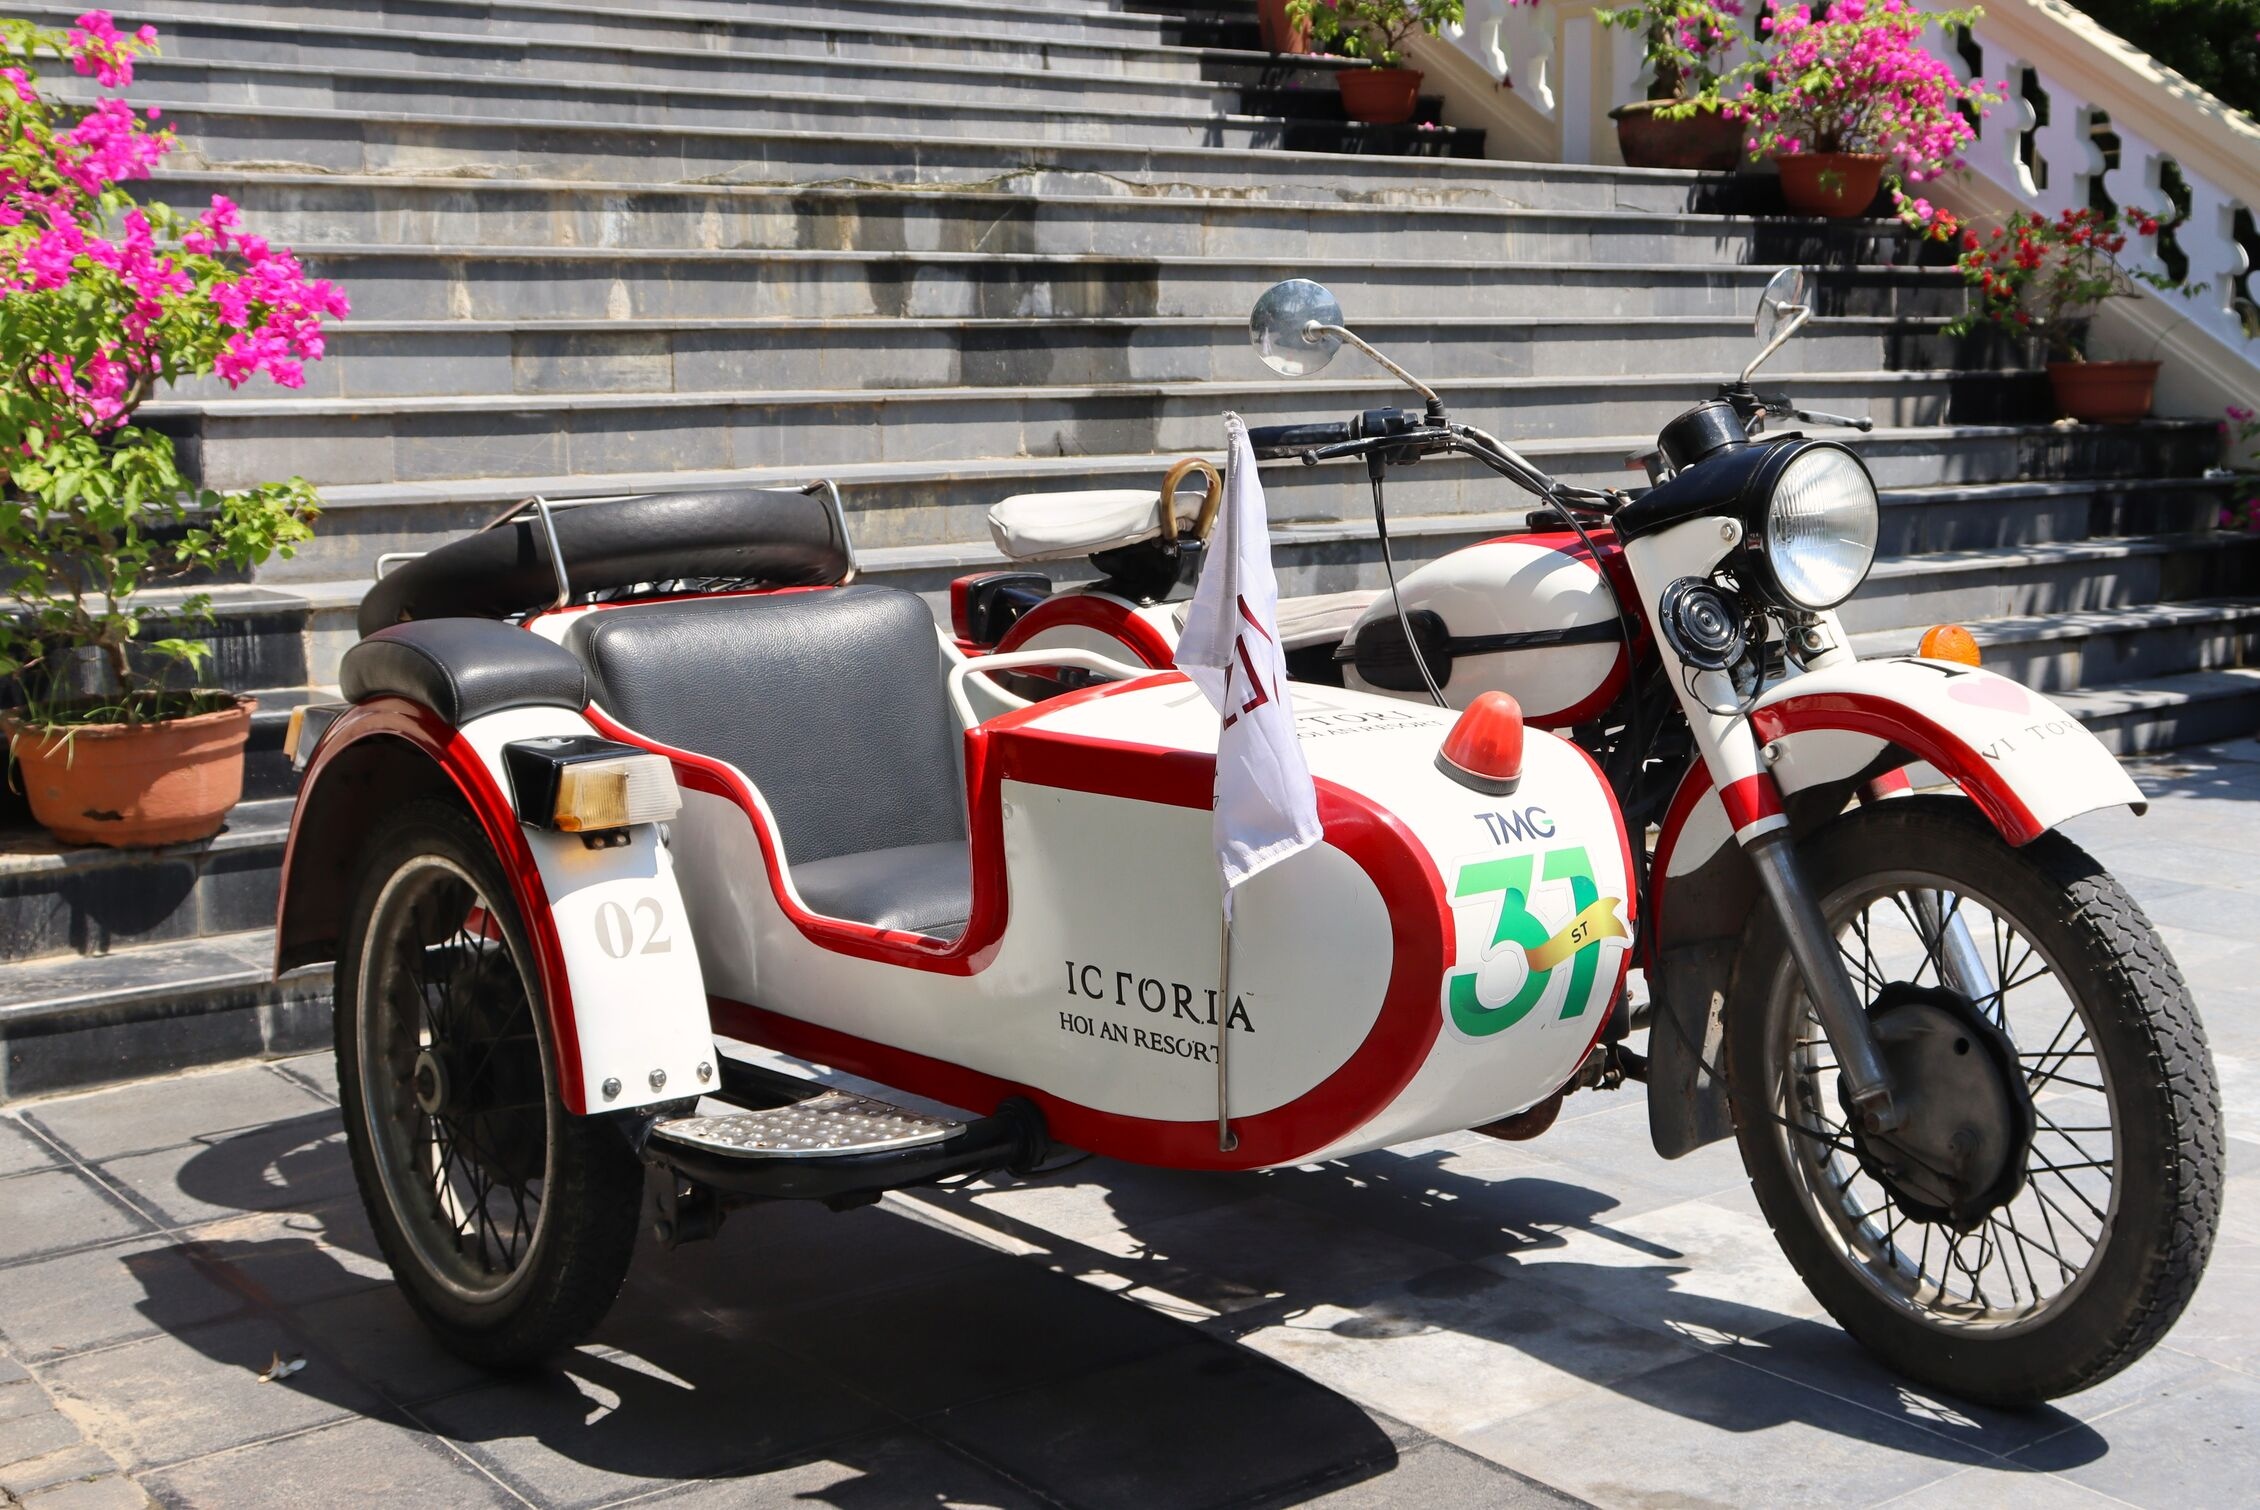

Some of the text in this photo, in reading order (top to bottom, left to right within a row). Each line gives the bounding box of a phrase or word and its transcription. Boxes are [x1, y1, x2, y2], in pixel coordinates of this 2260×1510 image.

[1474, 806, 1556, 846] TMG
[594, 896, 672, 959] 02
[1571, 920, 1589, 944] ST
[1059, 1011, 1095, 1036] HOI
[1100, 1020, 1128, 1045] AN
